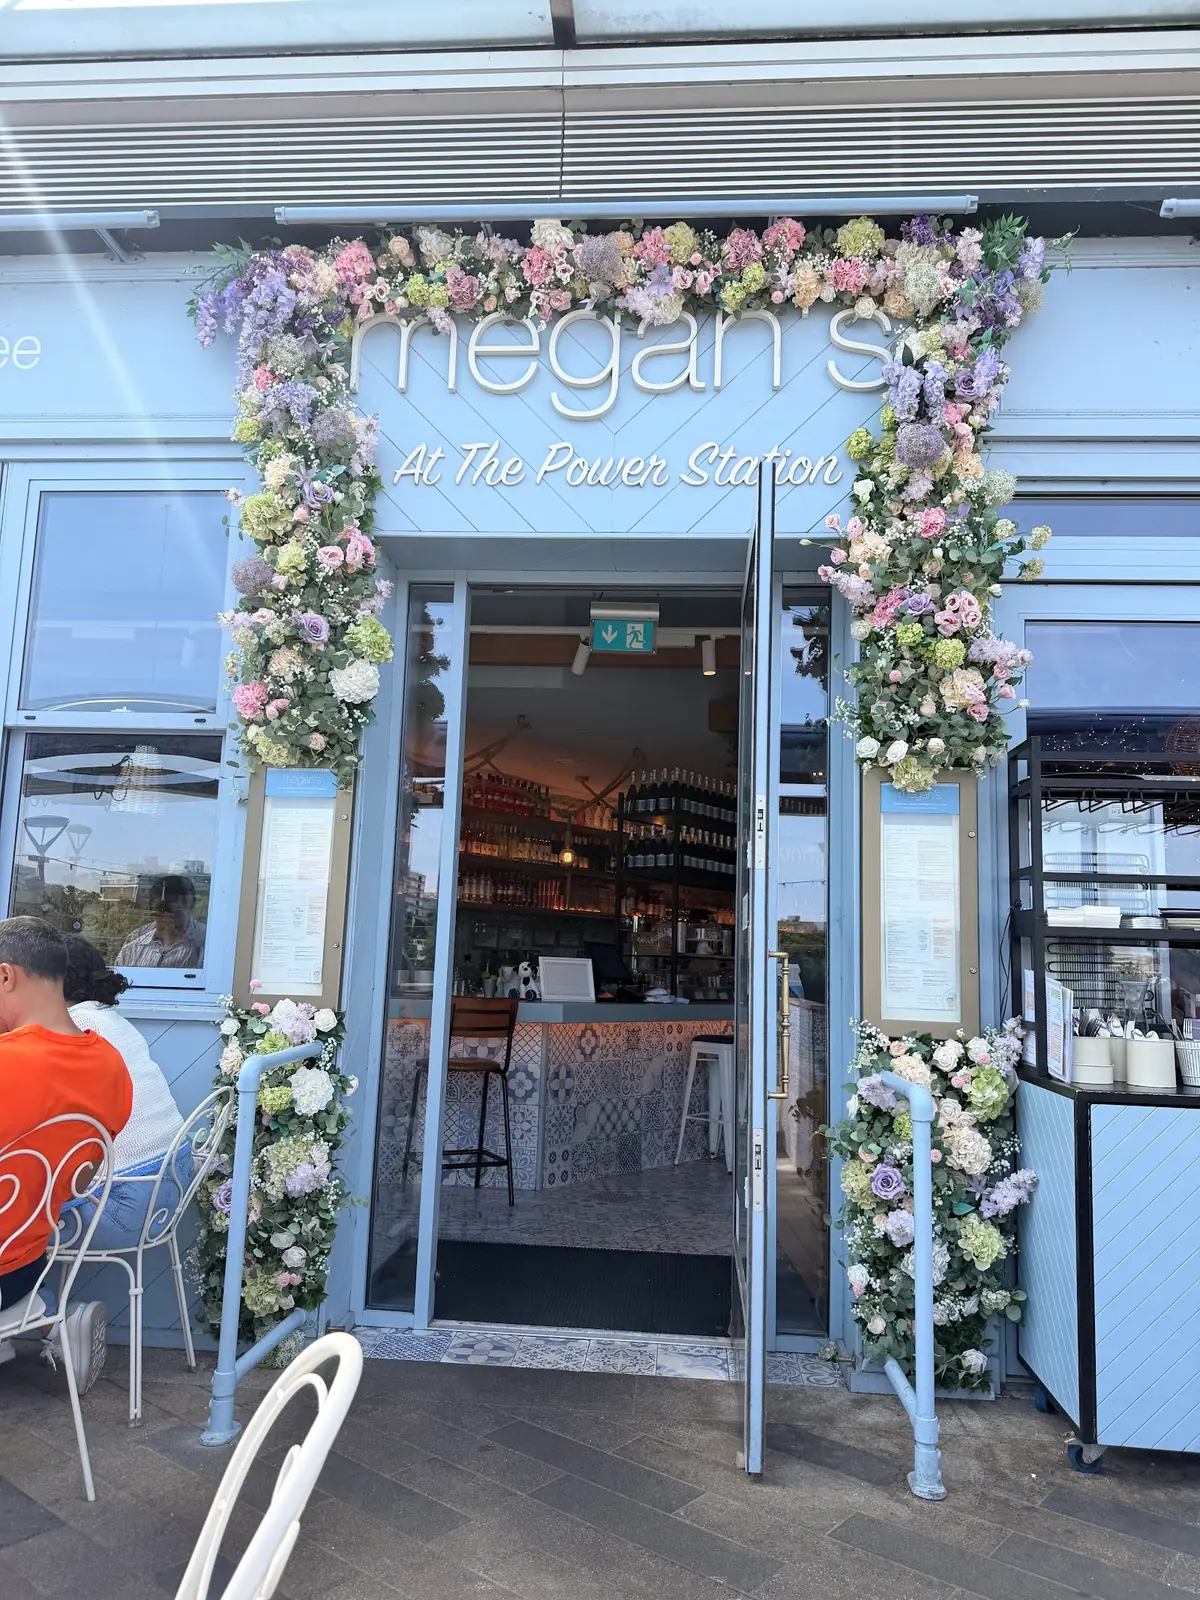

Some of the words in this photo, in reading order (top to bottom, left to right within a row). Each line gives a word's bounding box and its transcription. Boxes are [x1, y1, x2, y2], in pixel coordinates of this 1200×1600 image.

[393, 441, 445, 486] At
[455, 439, 526, 486] The
[535, 441, 669, 488] Power
[678, 441, 843, 487] Station
